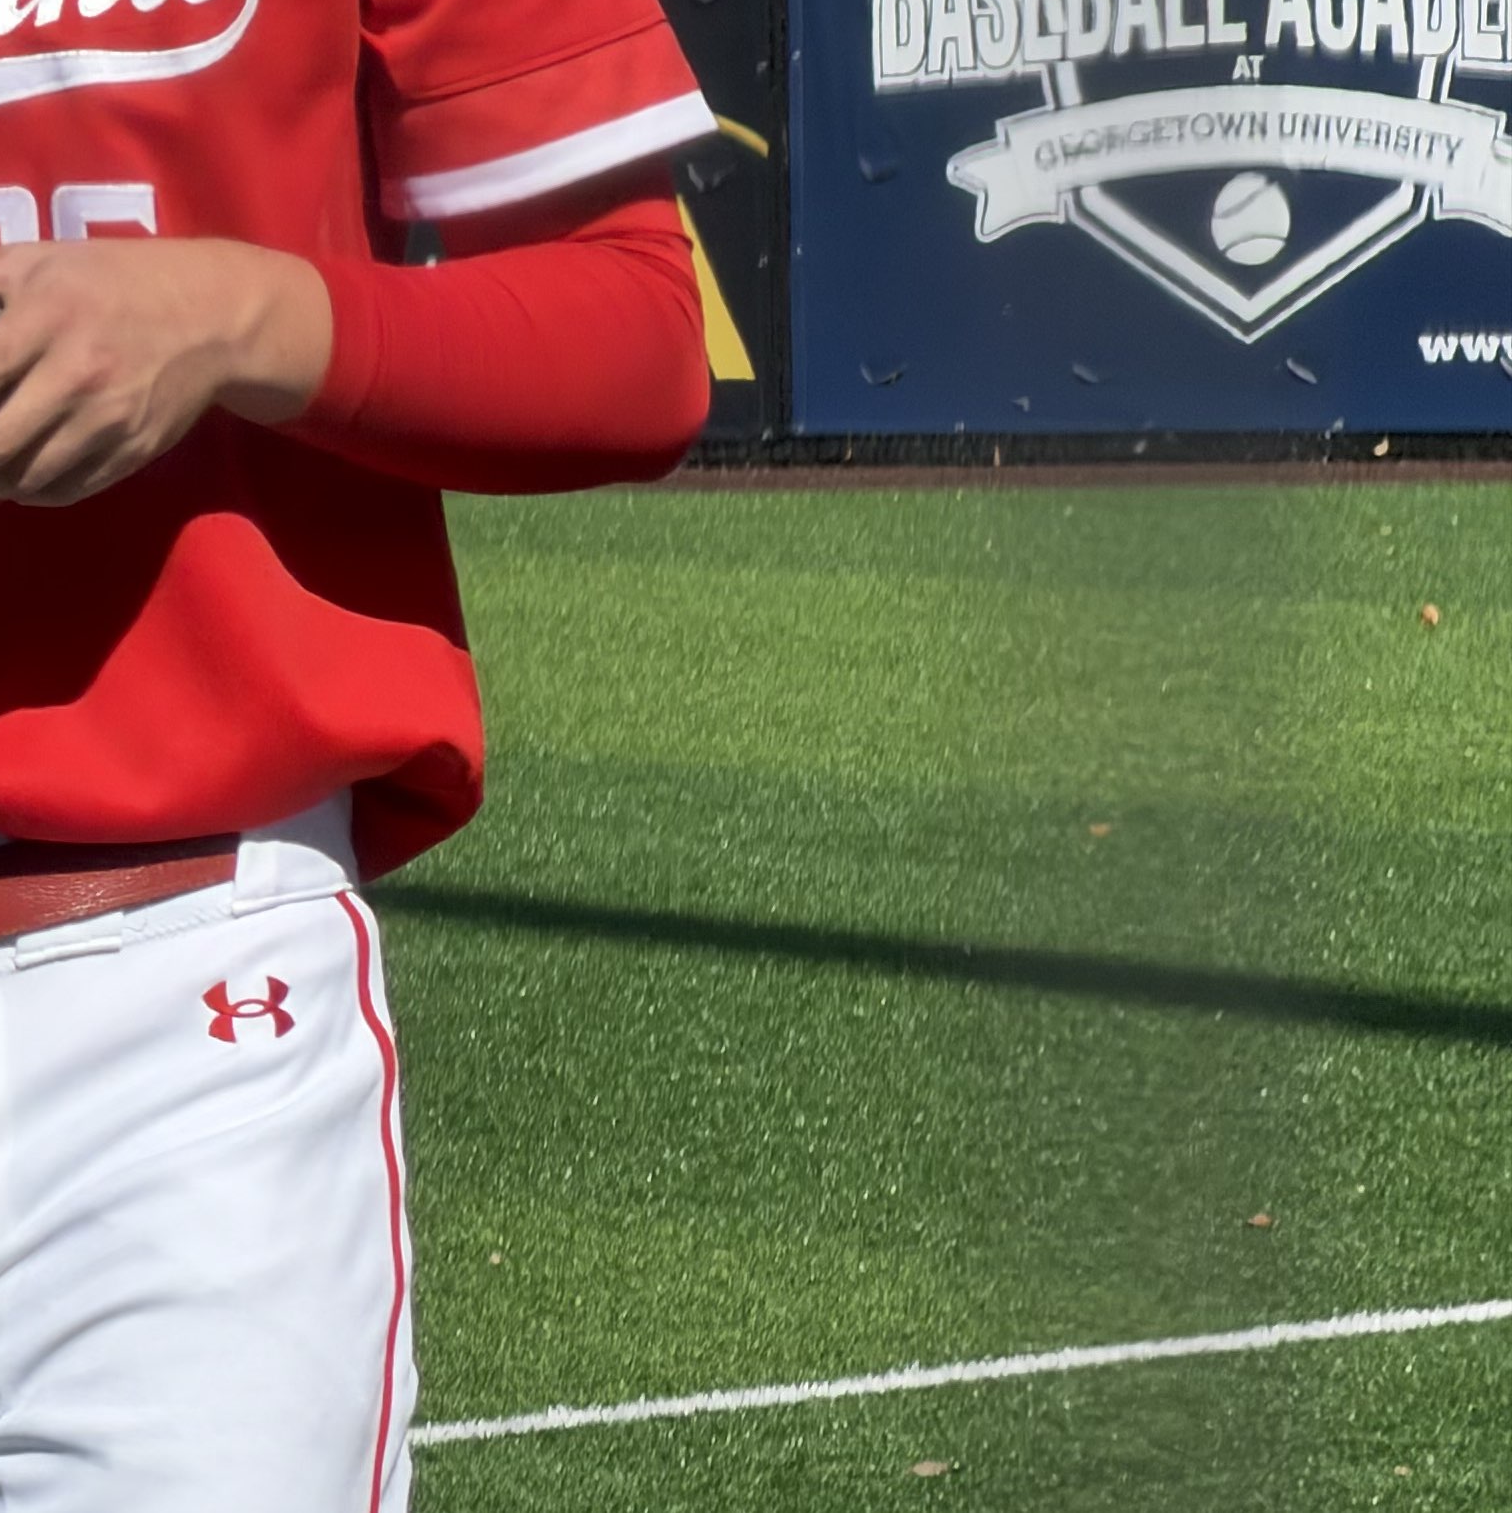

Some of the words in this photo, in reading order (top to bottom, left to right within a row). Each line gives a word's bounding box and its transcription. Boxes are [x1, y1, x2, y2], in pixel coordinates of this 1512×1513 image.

[1232, 54, 1266, 81] AT
[1034, 111, 1268, 171] GEORGETOWN
[1278, 111, 1465, 168] UNIVERSITY
[1417, 334, 1512, 363] ww
